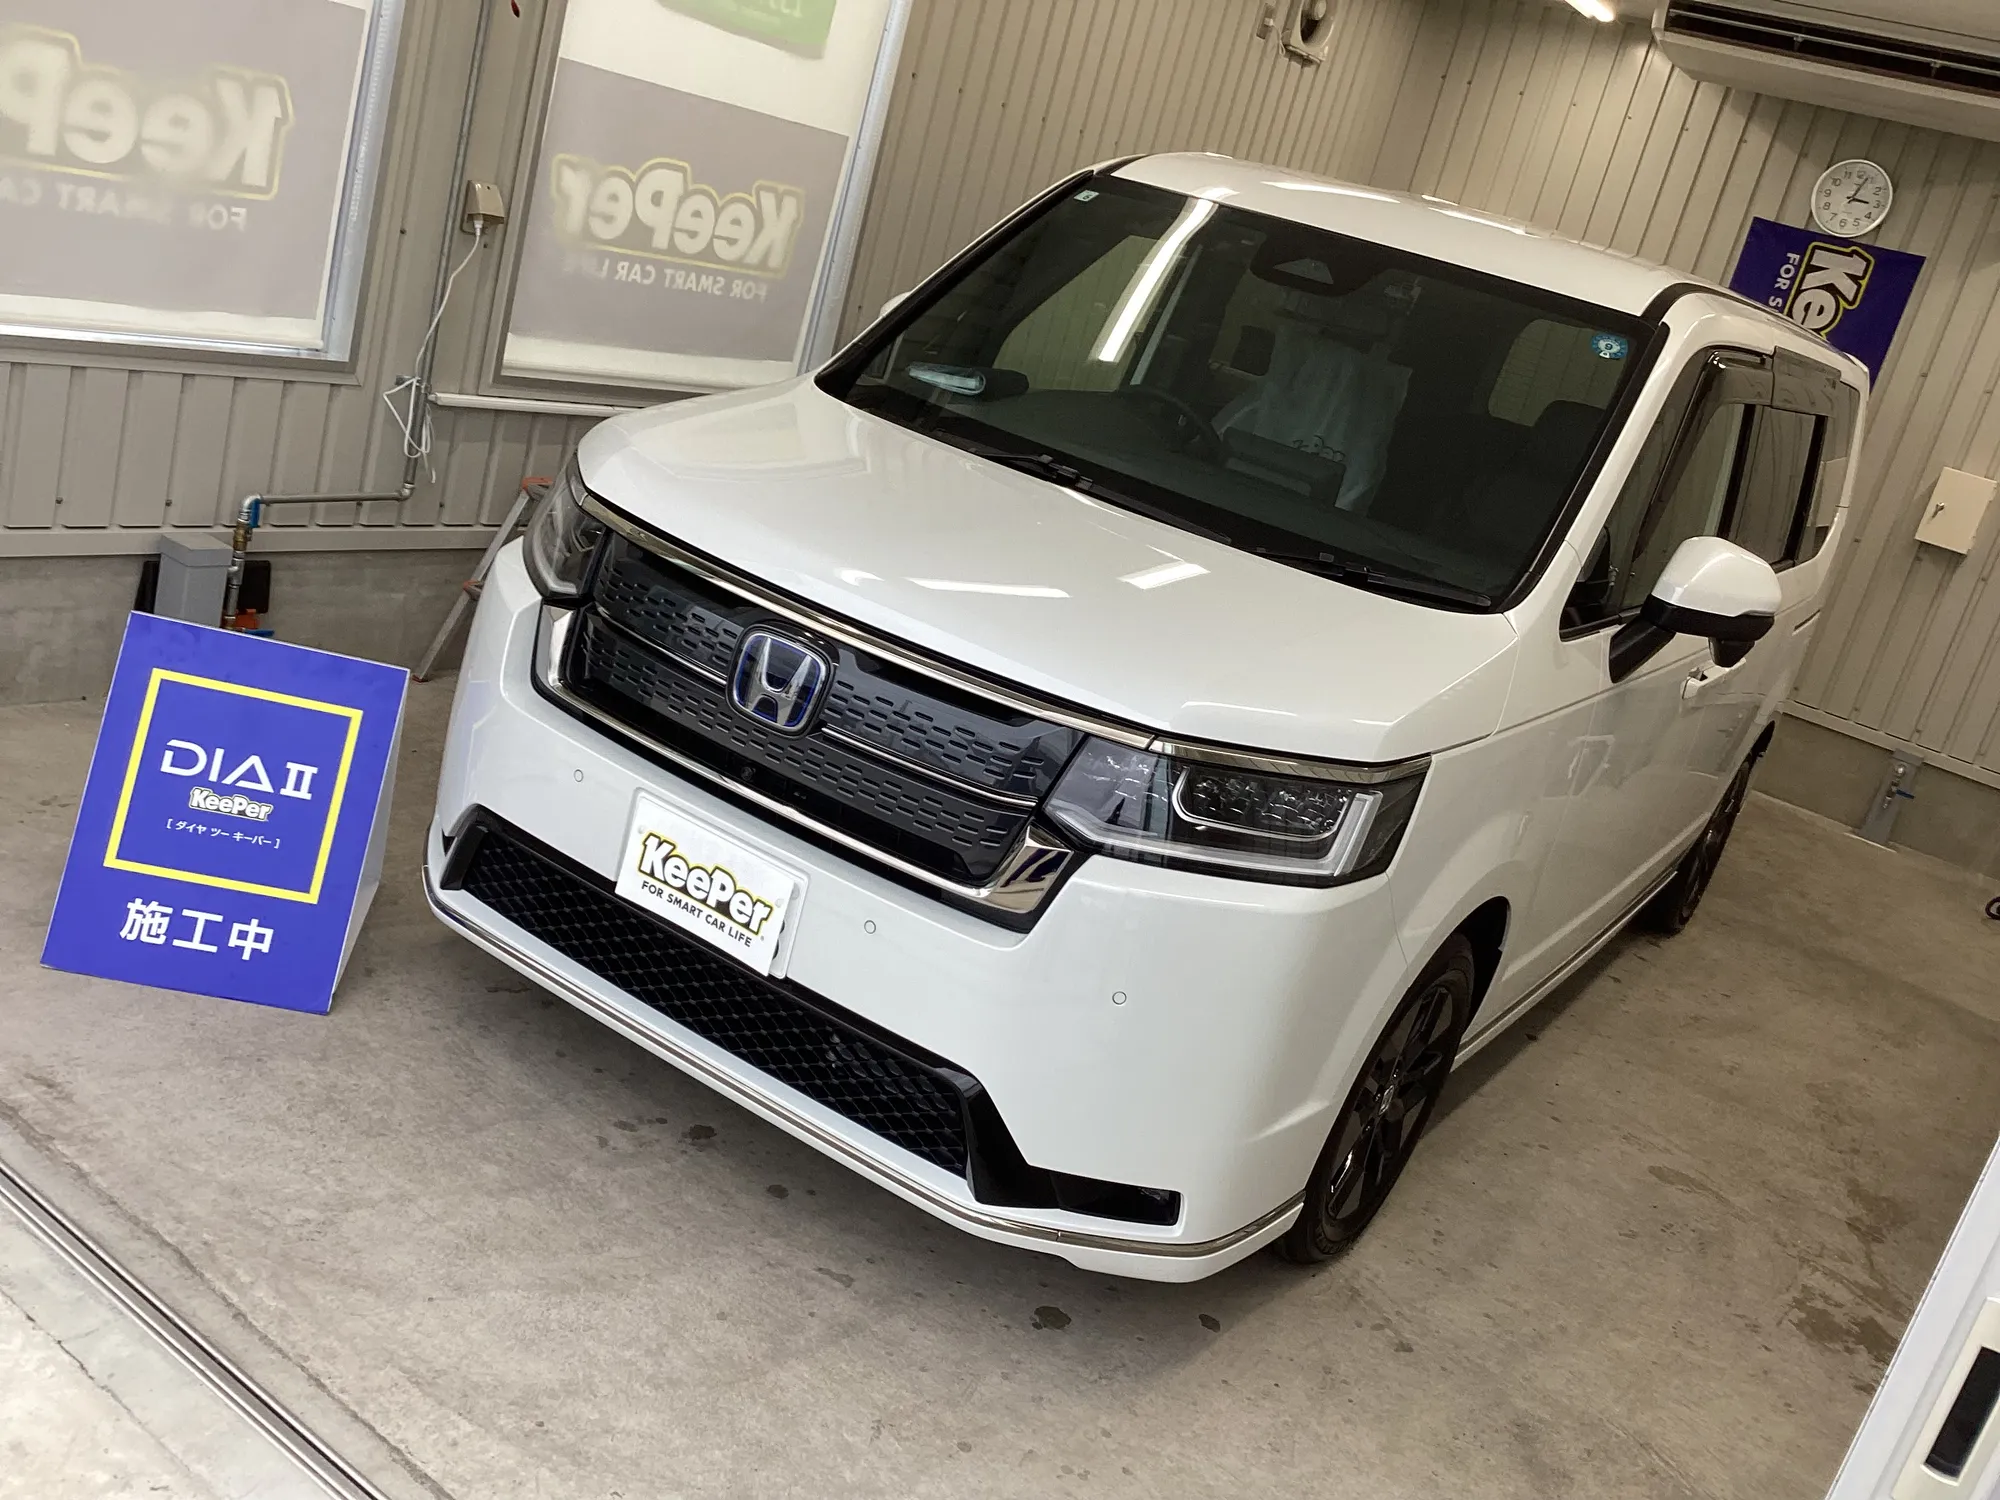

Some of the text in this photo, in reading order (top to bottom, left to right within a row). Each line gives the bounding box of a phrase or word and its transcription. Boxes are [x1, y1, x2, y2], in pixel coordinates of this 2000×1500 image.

[1774, 252, 1800, 290] FOR
[189, 787, 273, 822] KeePer
[638, 832, 773, 936] KeePer
[641, 880, 753, 948] FOR SMART CAR LIFE
[119, 897, 275, 961] 施工中
